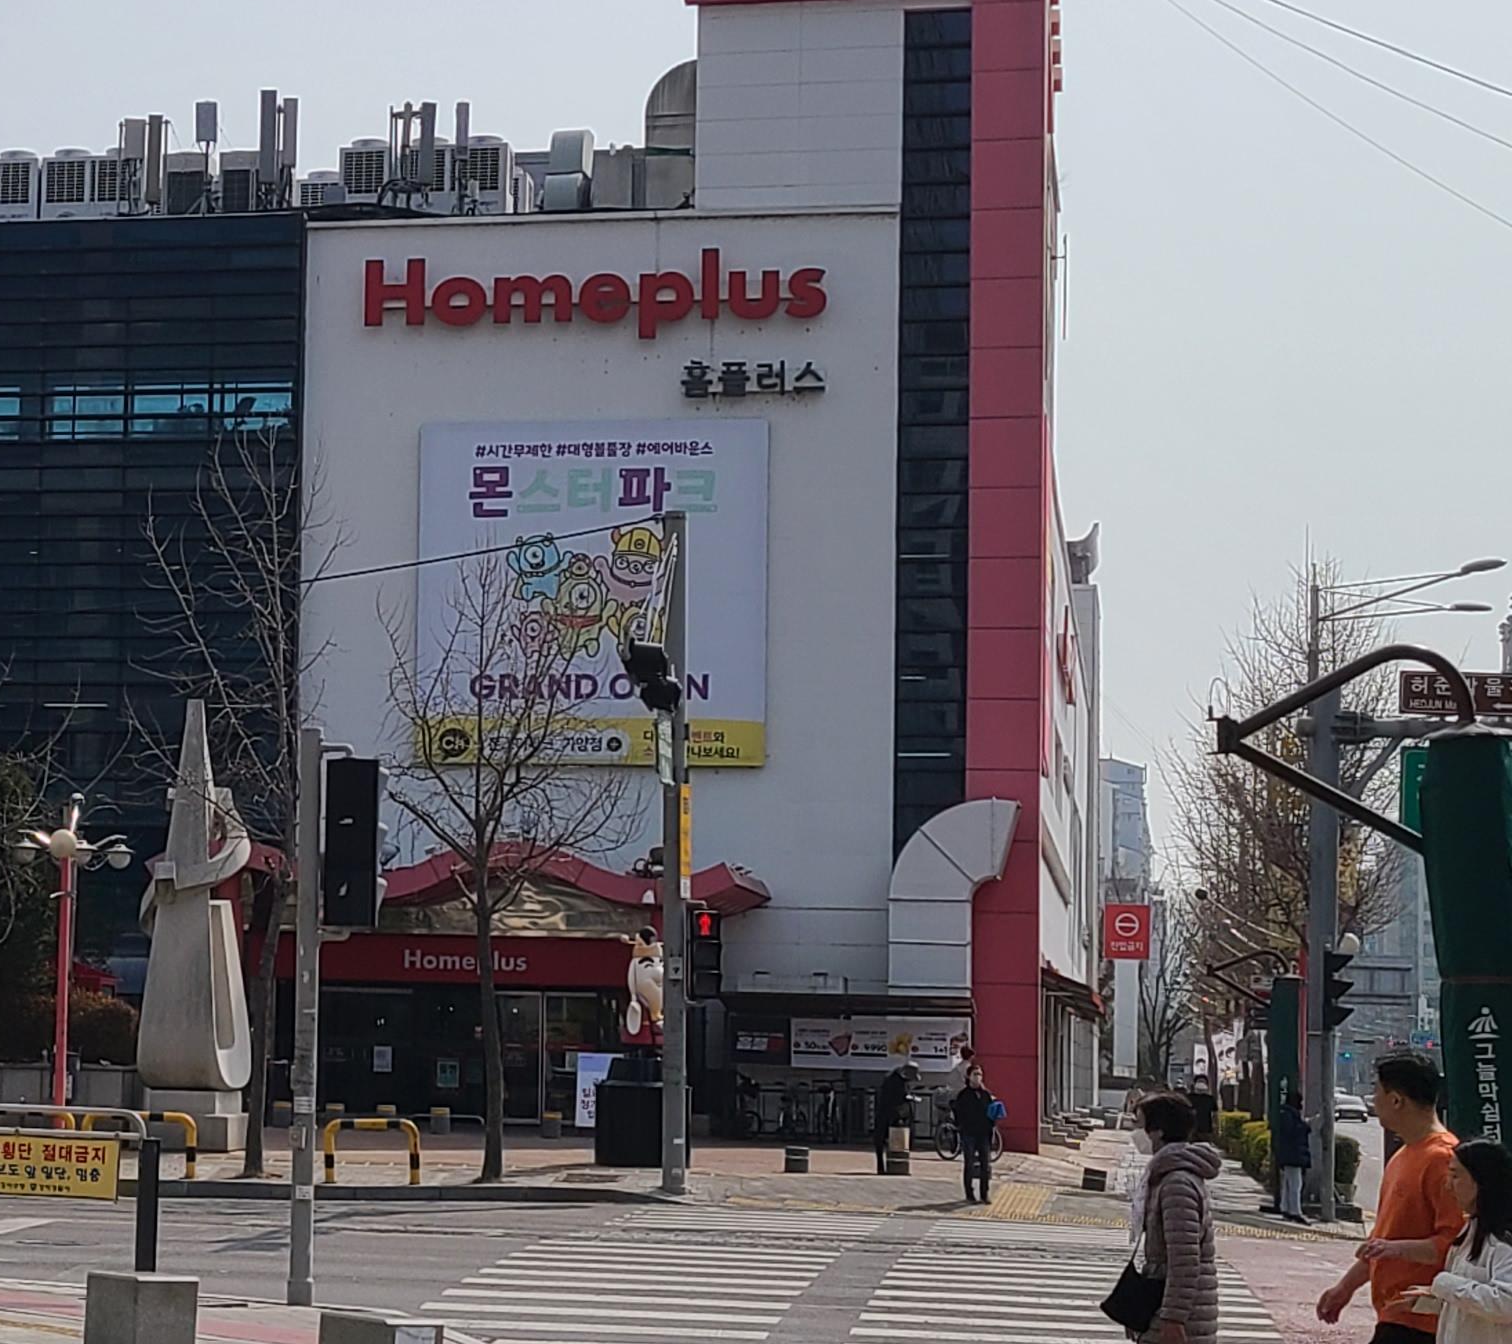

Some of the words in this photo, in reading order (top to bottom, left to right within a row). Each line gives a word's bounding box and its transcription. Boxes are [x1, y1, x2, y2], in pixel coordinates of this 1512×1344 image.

[364, 248, 827, 339] Homeplus
[680, 360, 826, 398] 홈플러스
[469, 466, 718, 518] 몬스터파크
[469, 672, 599, 700] GRAND
[609, 672, 710, 700] ON
[1409, 675, 1512, 698] 허준물
[686, 744, 740, 759] 나보세요!
[42, 1143, 107, 1165] 절대금지
